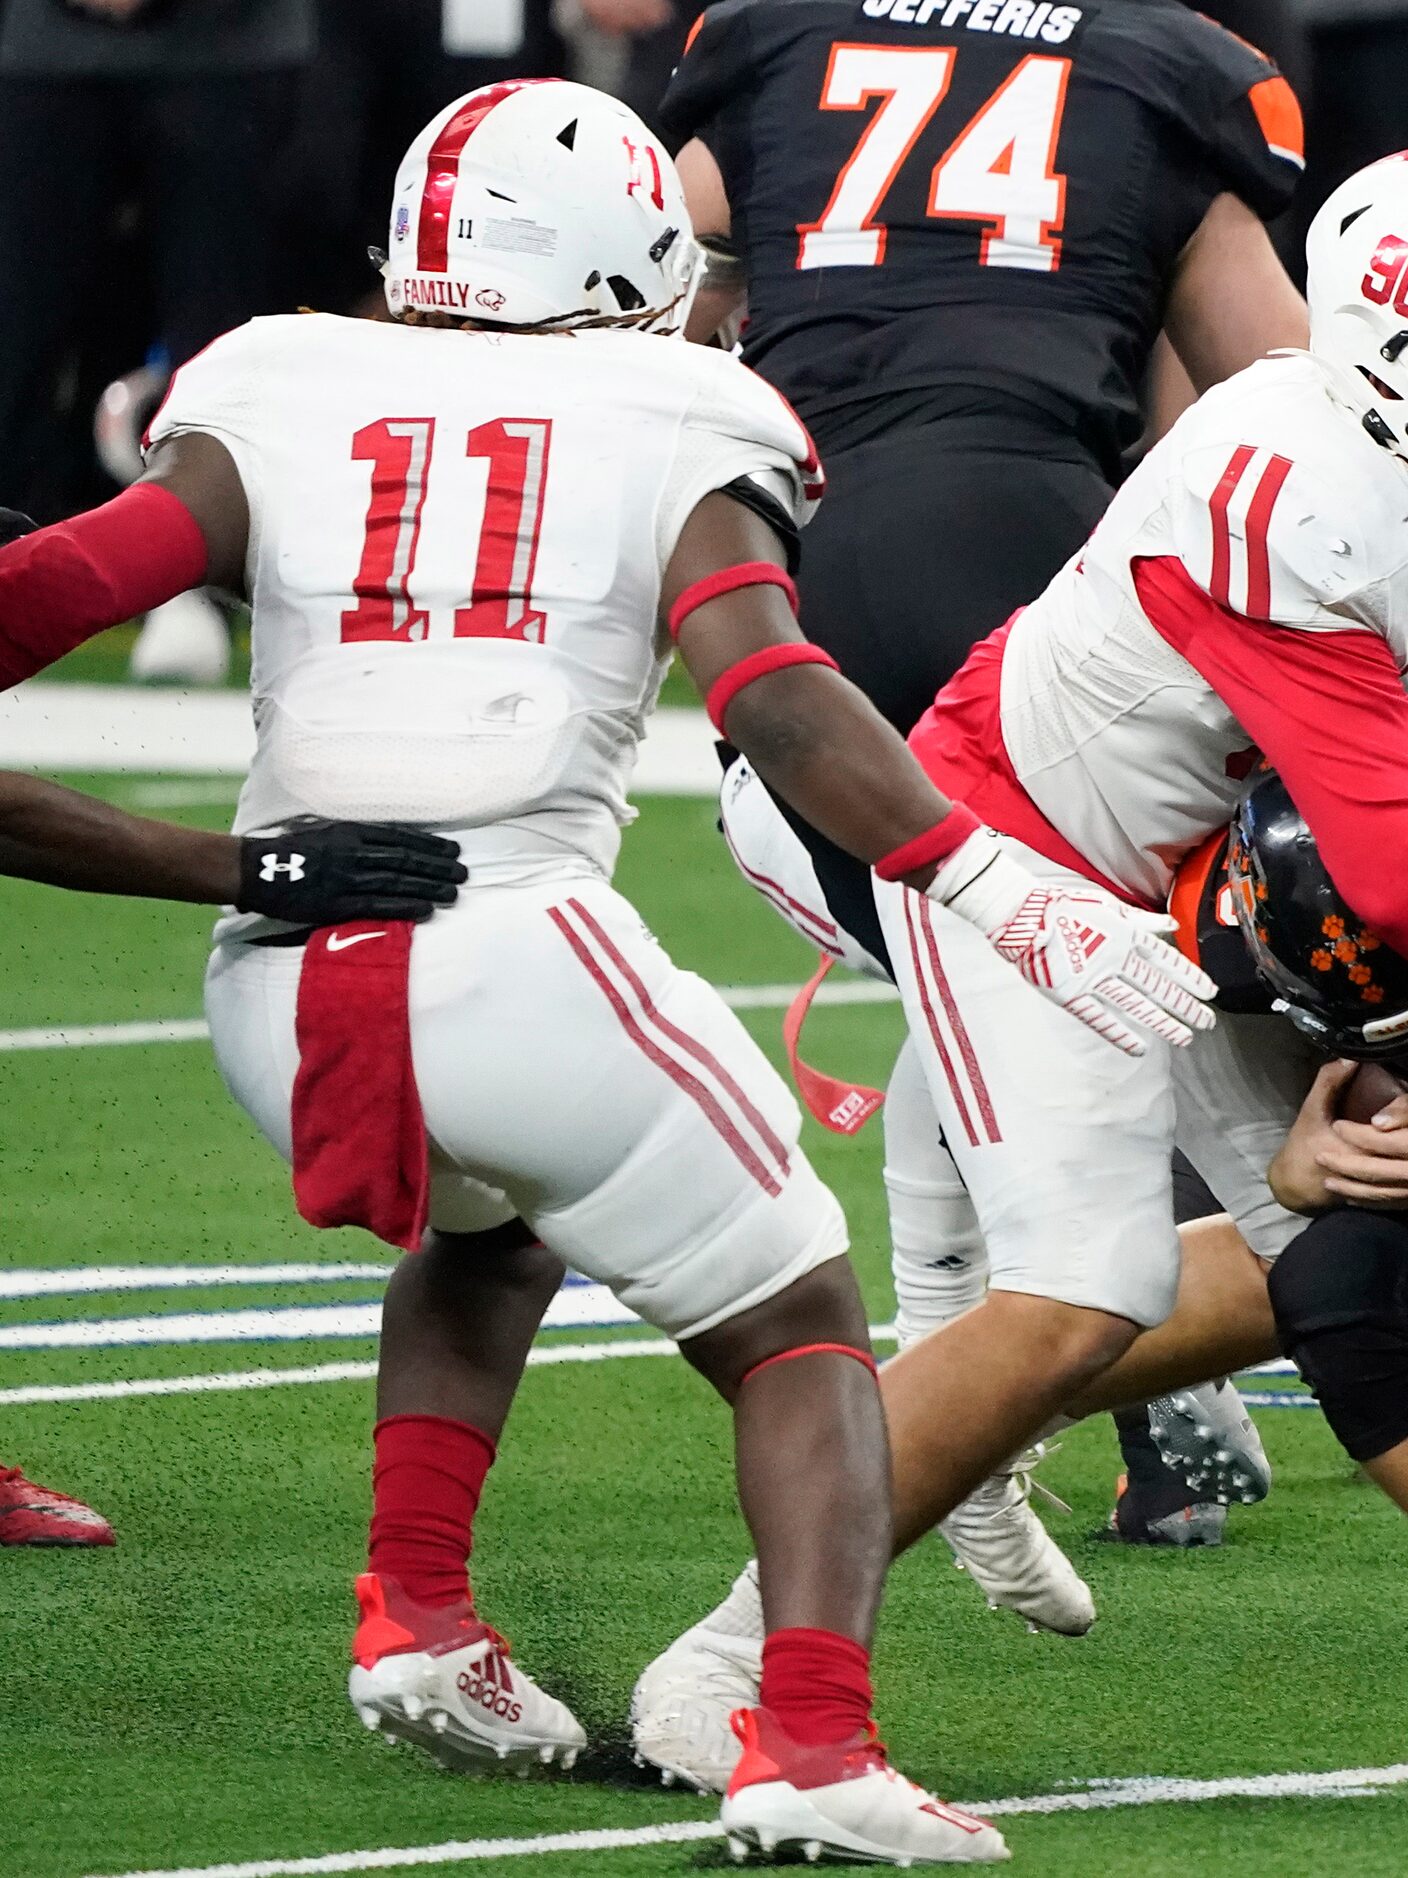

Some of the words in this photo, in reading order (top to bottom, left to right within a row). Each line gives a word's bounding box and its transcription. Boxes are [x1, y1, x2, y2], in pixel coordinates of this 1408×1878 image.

[622, 136, 664, 212] 11
[795, 41, 1073, 272] 74
[458, 218, 473, 239] 11
[403, 278, 470, 308] FAMILY
[340, 416, 553, 644] 11
[1056, 915, 1084, 974] adidas
[456, 1671, 523, 1723] adidas
